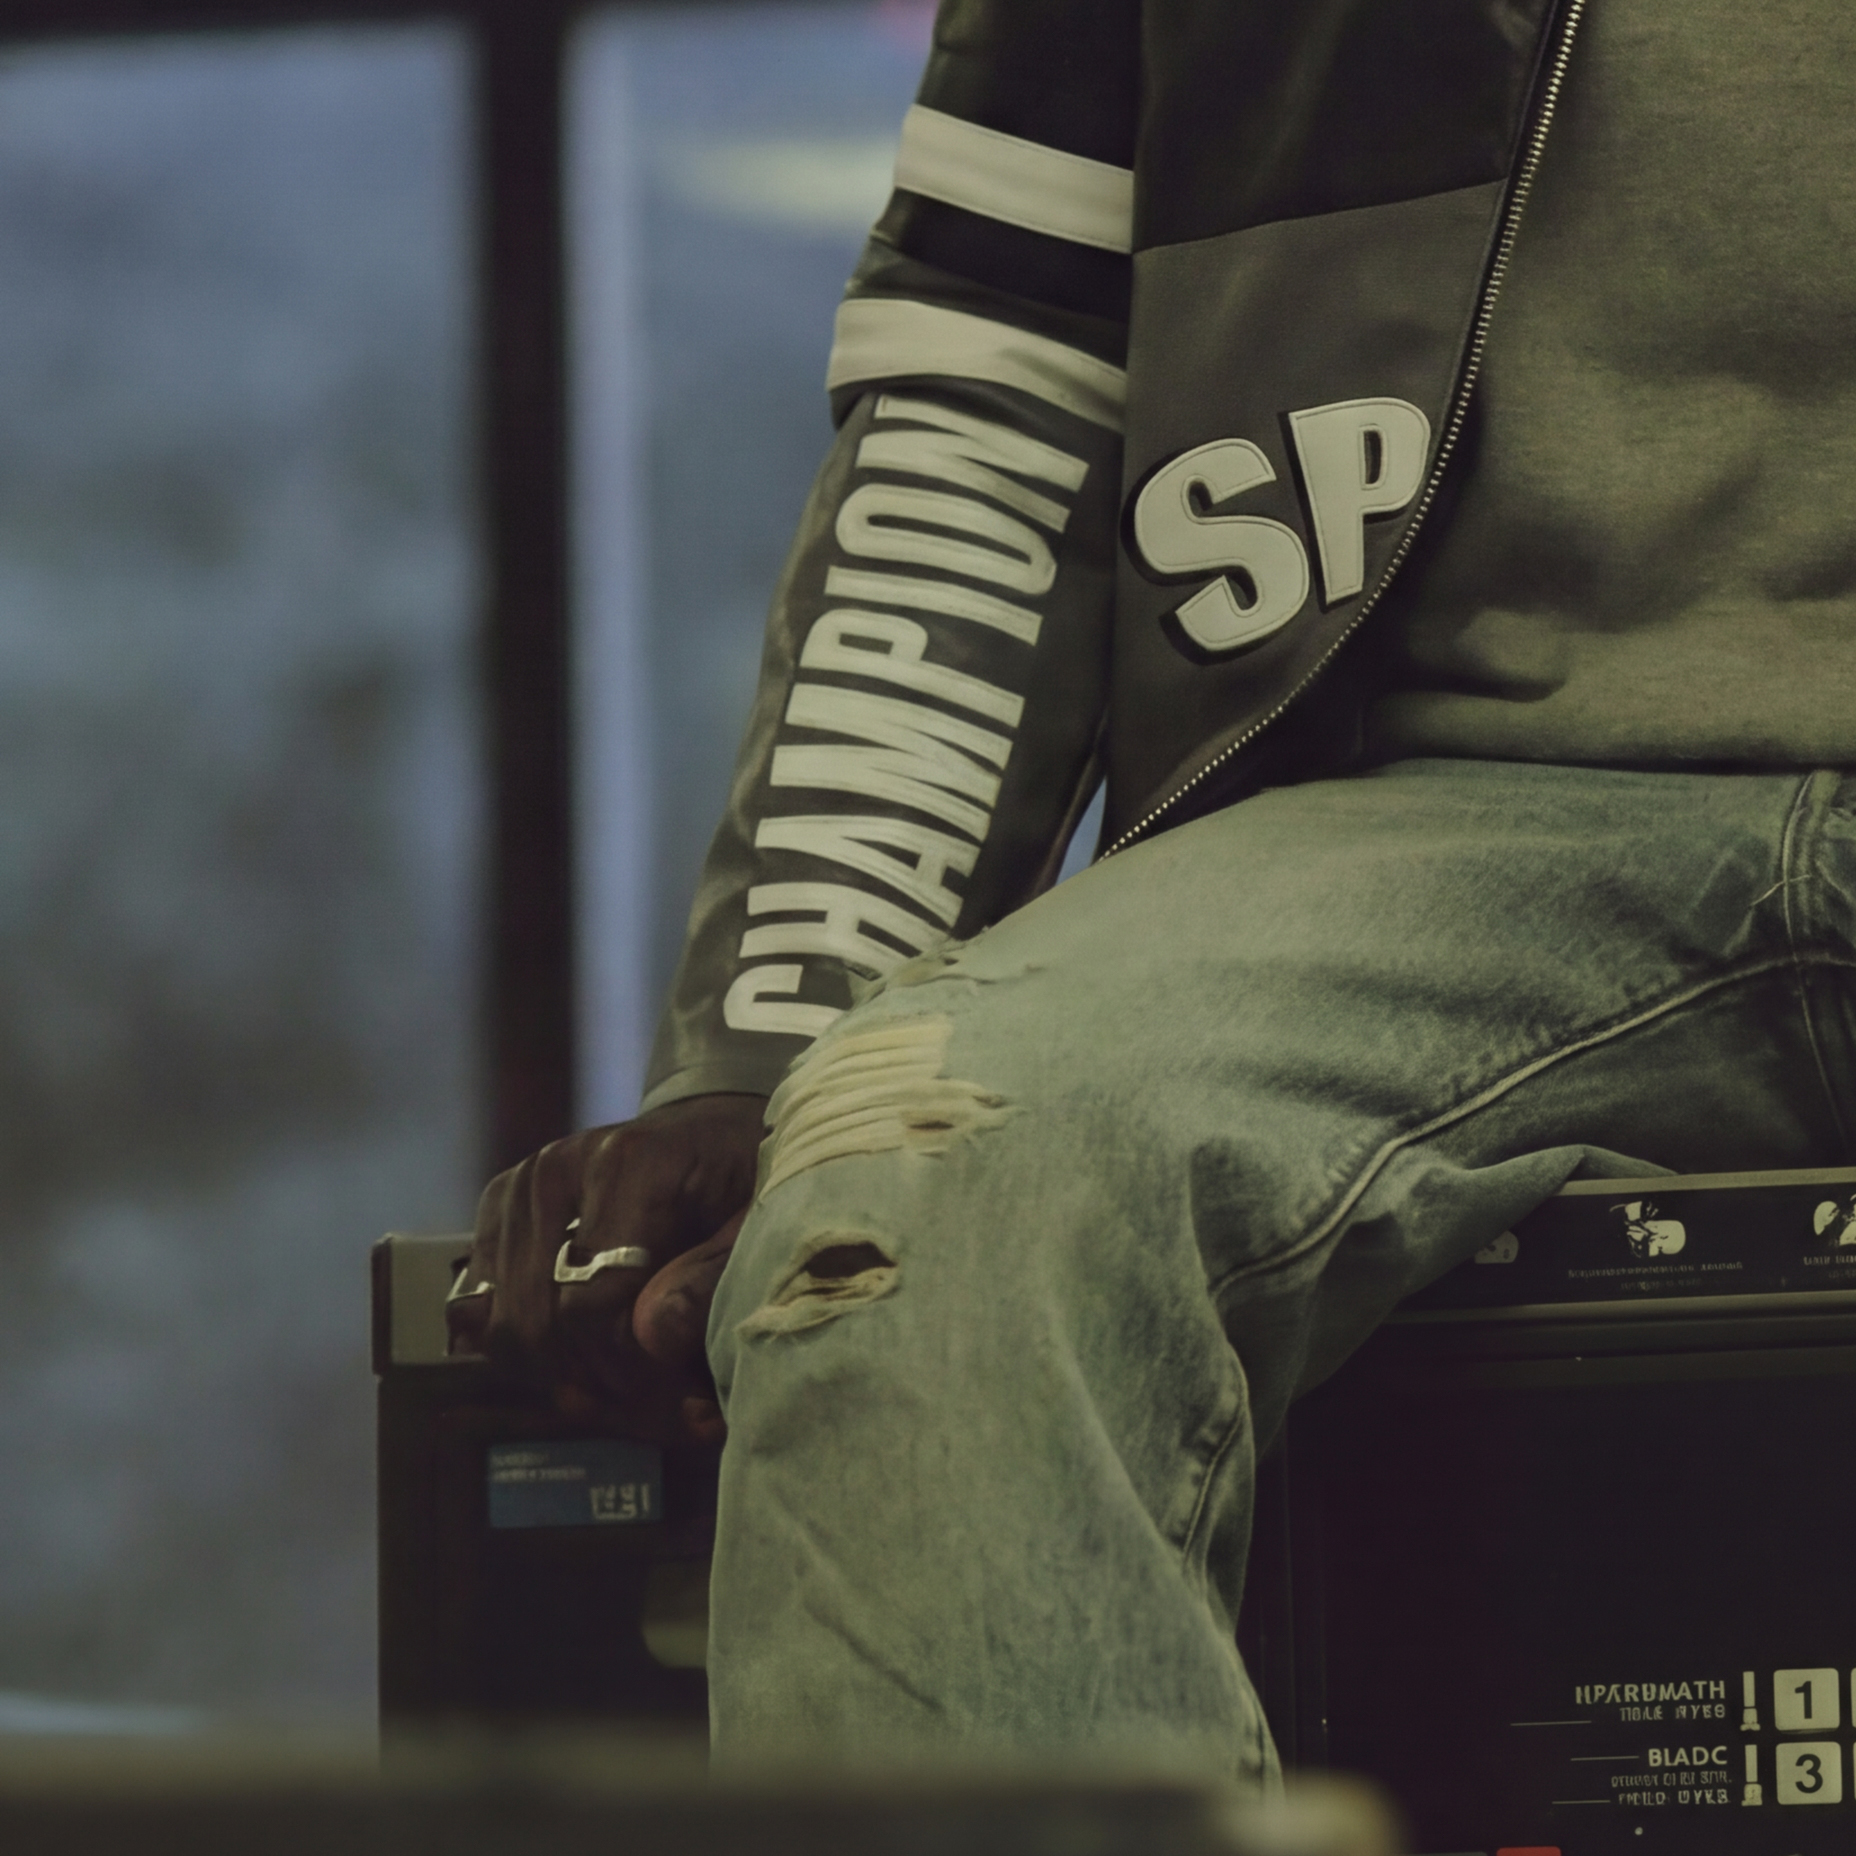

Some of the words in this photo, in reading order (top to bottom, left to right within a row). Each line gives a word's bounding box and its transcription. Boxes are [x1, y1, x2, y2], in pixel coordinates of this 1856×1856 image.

[1134, 397, 1431, 652] SP
[723, 394, 1090, 1039] CHAMPION
[1794, 1680, 1812, 1719] 1
[1648, 1745, 1728, 1767] BLADC
[1795, 1753, 1824, 1794] 3
